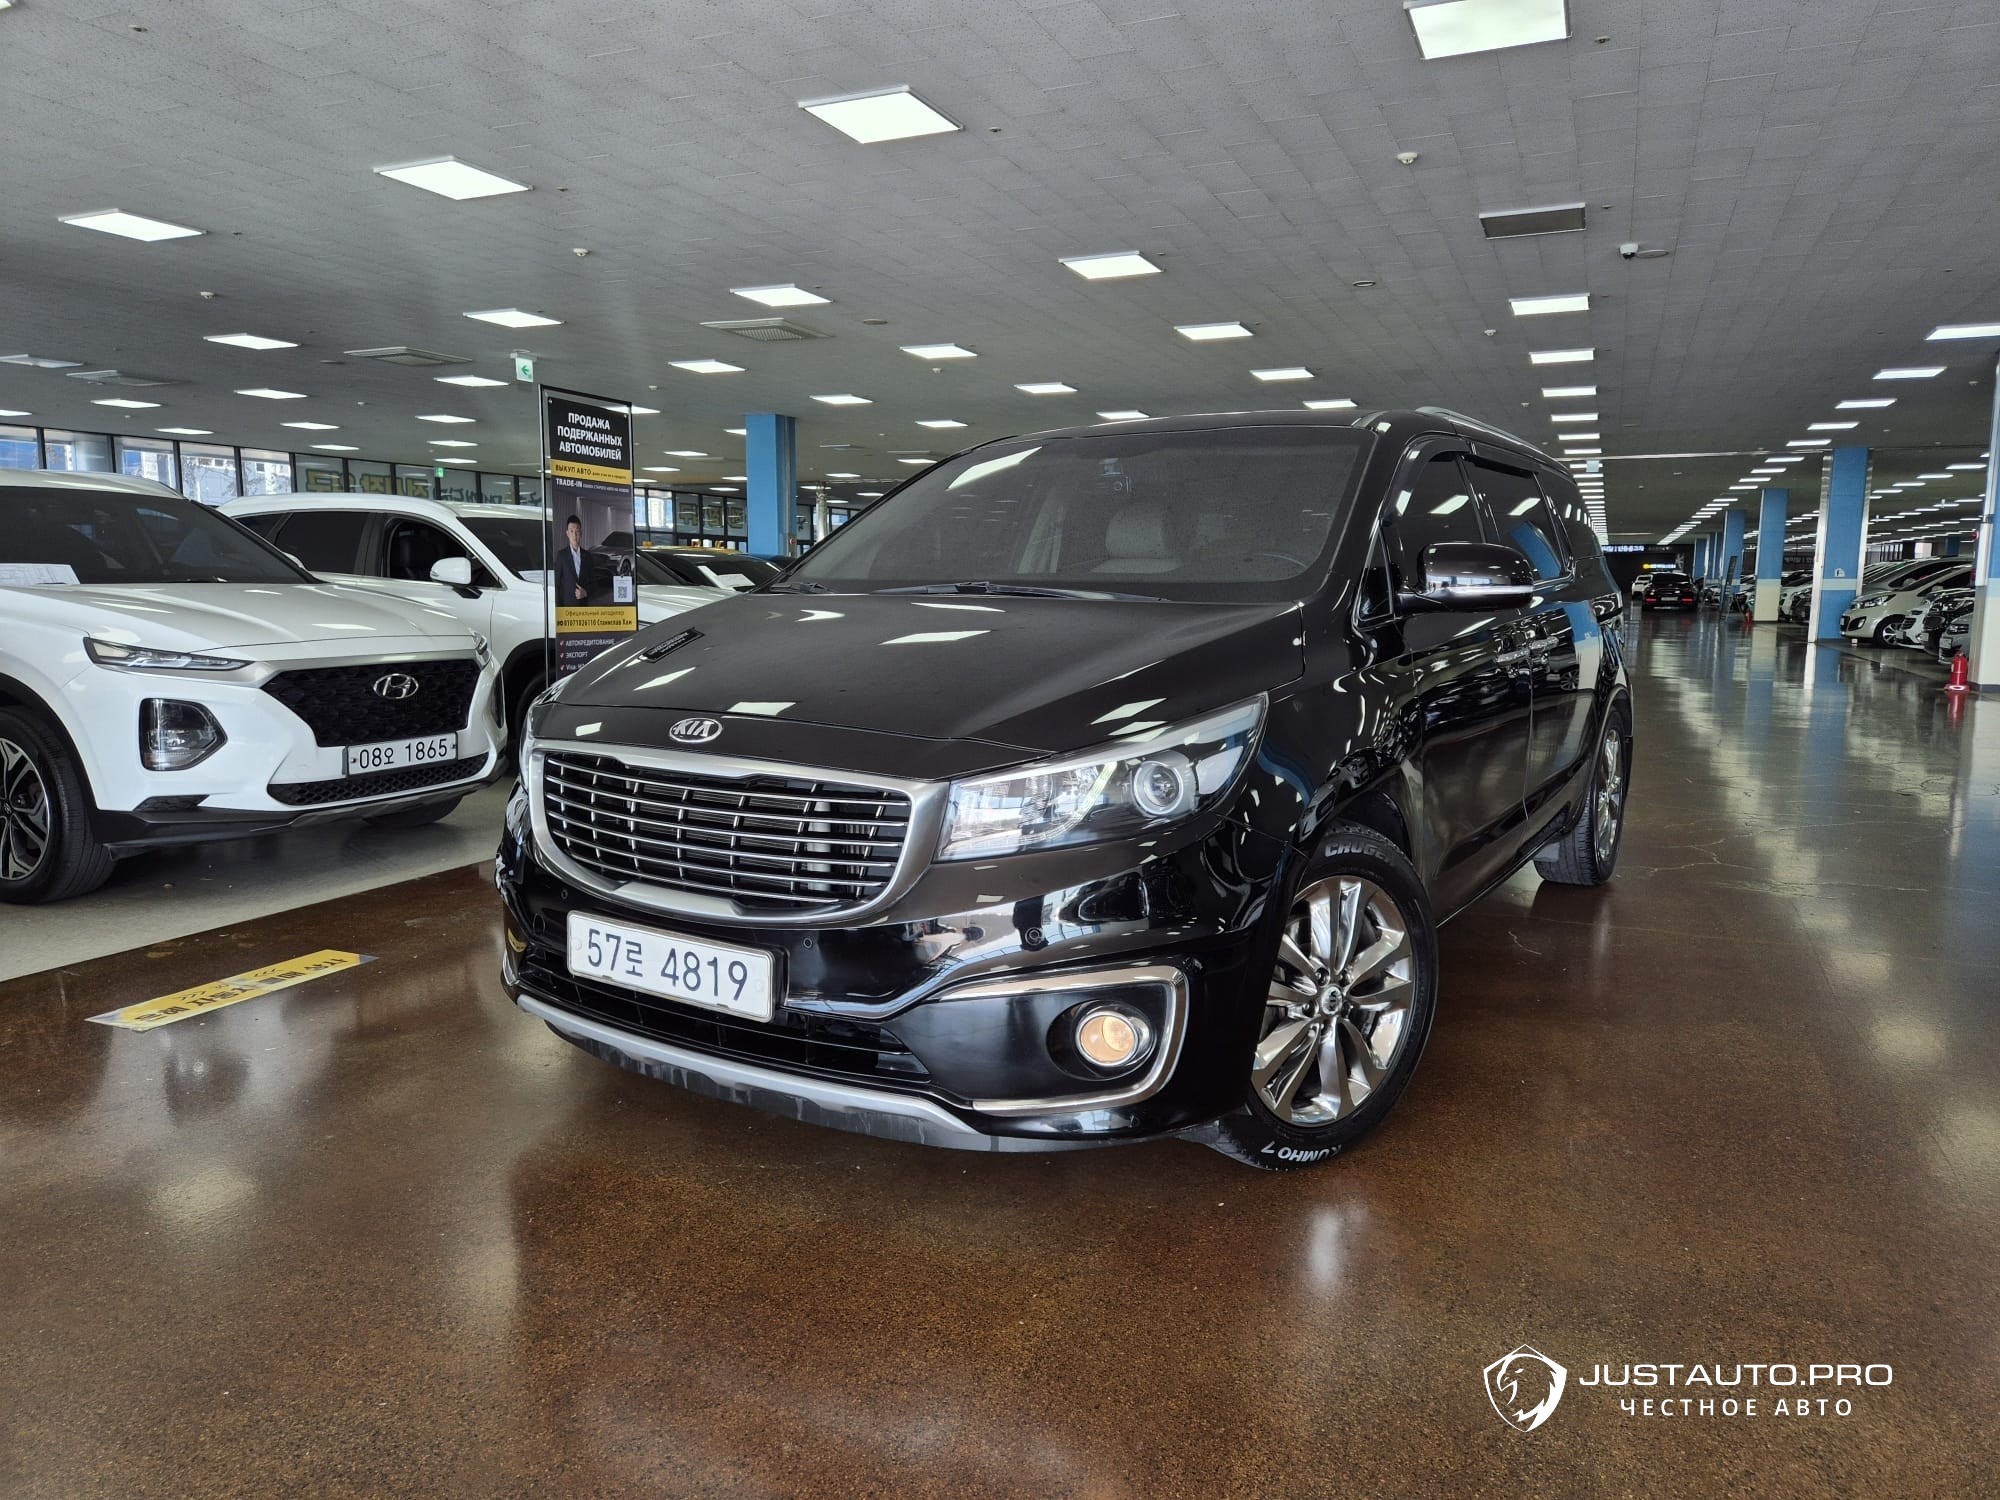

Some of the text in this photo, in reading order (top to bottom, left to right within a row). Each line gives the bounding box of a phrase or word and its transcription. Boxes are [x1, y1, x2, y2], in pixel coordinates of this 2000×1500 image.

[568, 412, 611, 430] ПРОДАЖА
[557, 425, 623, 447] ПОДЕРЖАННЫХ
[559, 441, 622, 461] АВТОМОБИЛЕЙ
[555, 464, 591, 475] ВЫКУП АВТО
[555, 478, 583, 488] TRADE-IN
[566, 651, 588, 659] ЭКСПОРТ
[673, 720, 714, 737] KIA
[359, 738, 448, 769] 08오 1865
[587, 928, 748, 1001] 57로 4819
